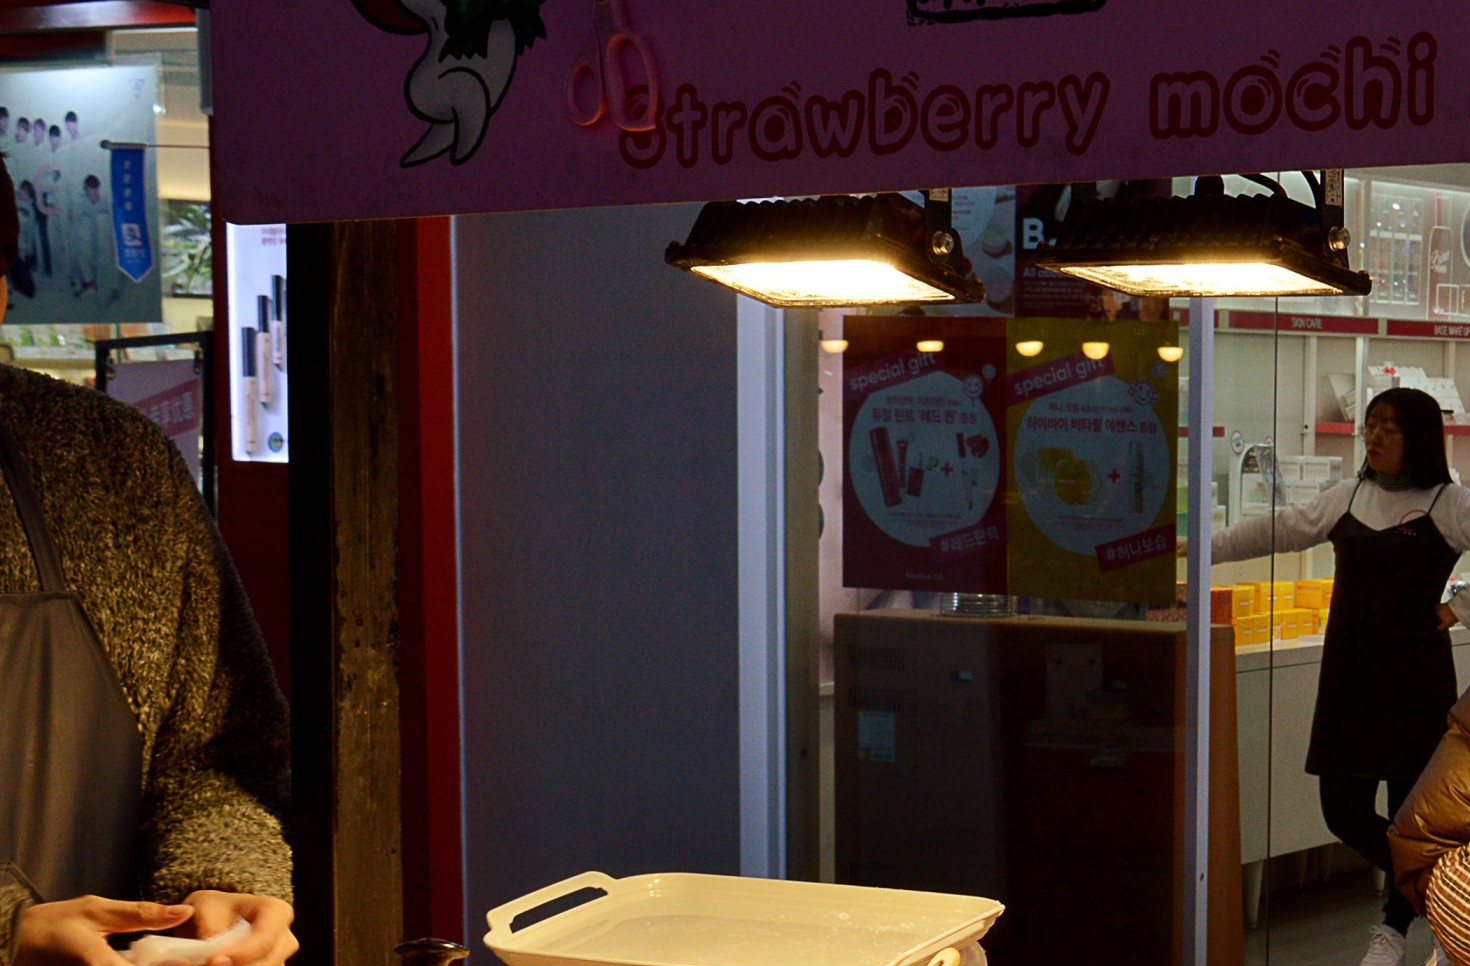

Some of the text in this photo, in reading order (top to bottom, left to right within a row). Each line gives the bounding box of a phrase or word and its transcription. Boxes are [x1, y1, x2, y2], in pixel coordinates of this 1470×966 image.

[1150, 31, 1438, 139] mochi
[850, 358, 905, 391] special
[1014, 362, 1072, 397] special
